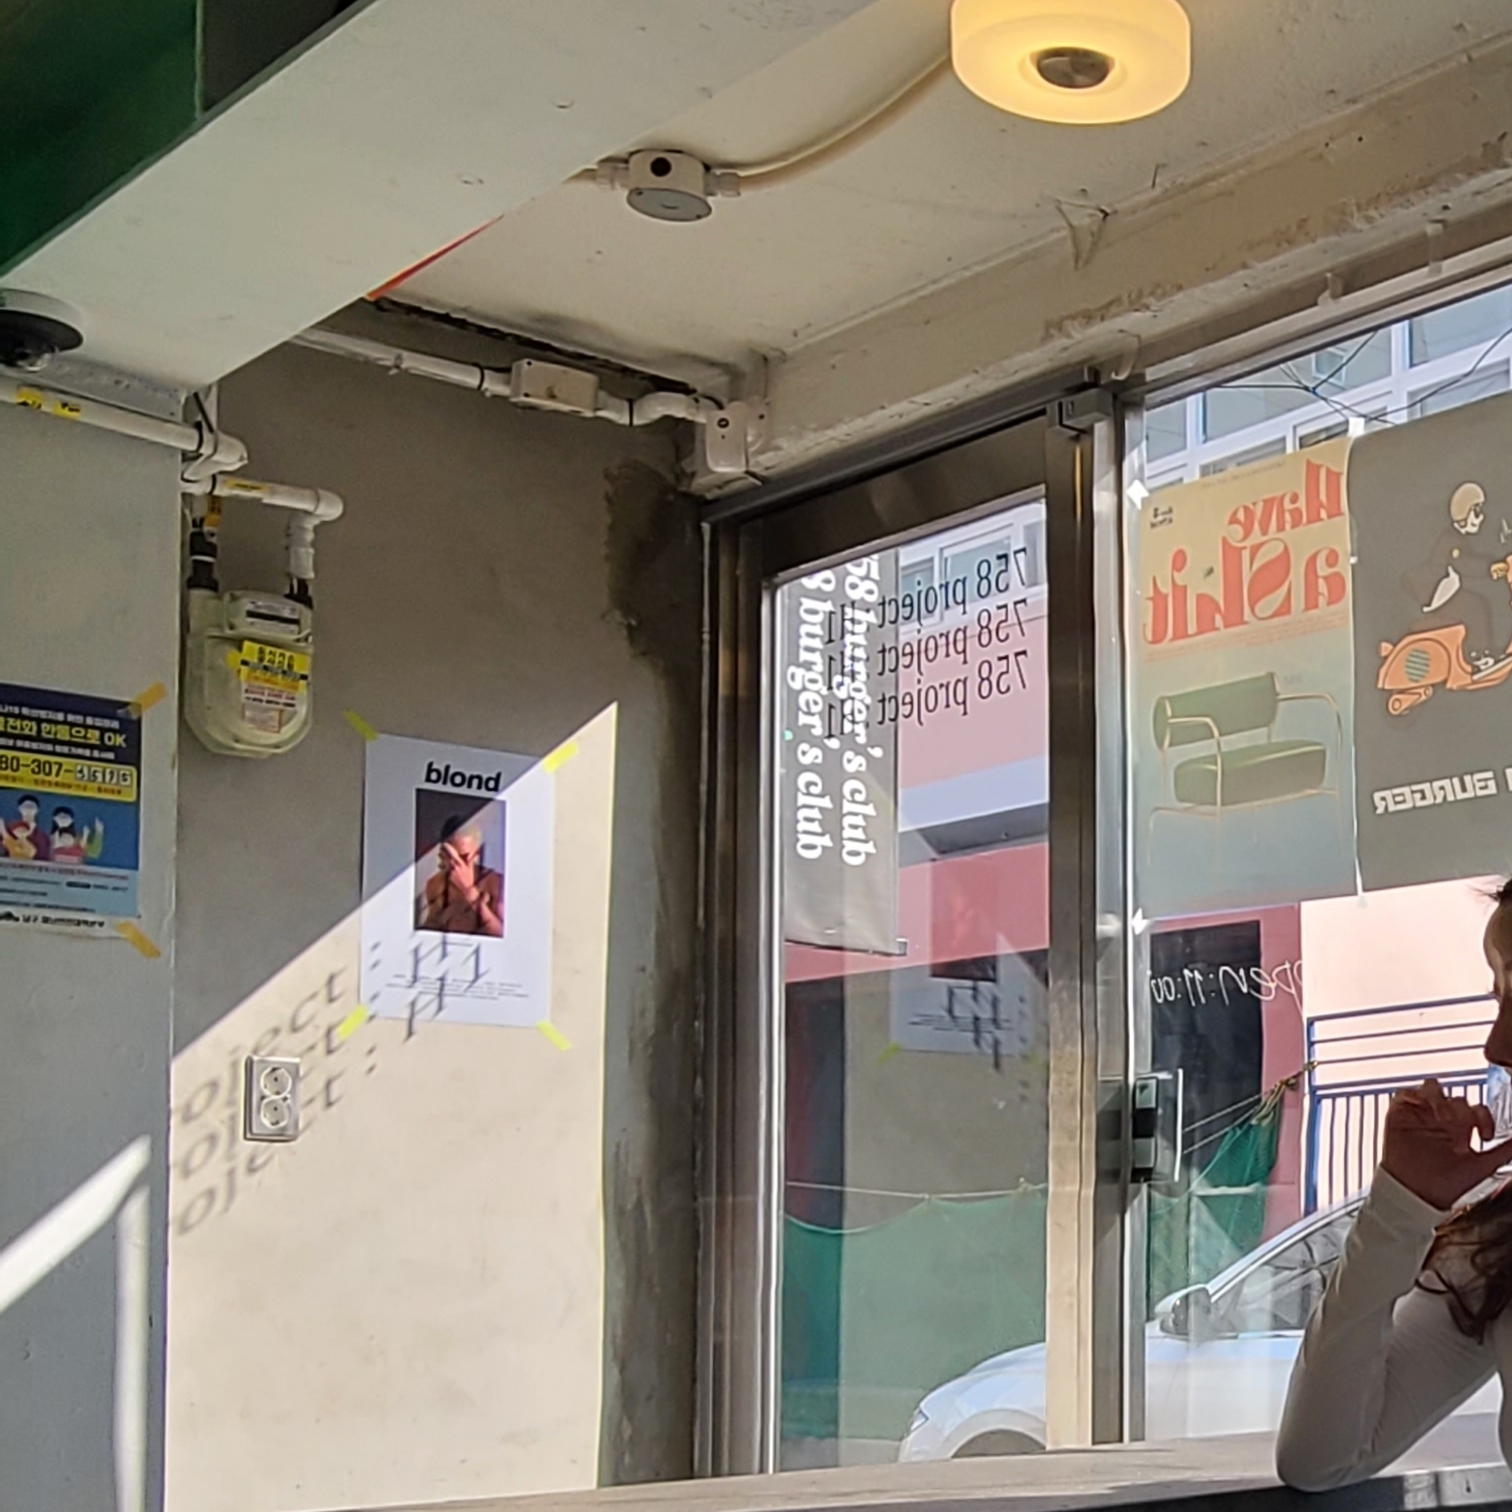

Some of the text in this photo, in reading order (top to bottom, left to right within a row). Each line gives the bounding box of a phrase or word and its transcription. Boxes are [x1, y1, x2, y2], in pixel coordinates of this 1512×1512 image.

[786, 597, 842, 765] burger's
[104, 732, 127, 748] OK
[424, 760, 503, 793] blond
[795, 771, 834, 859] club
[841, 778, 878, 866] club
